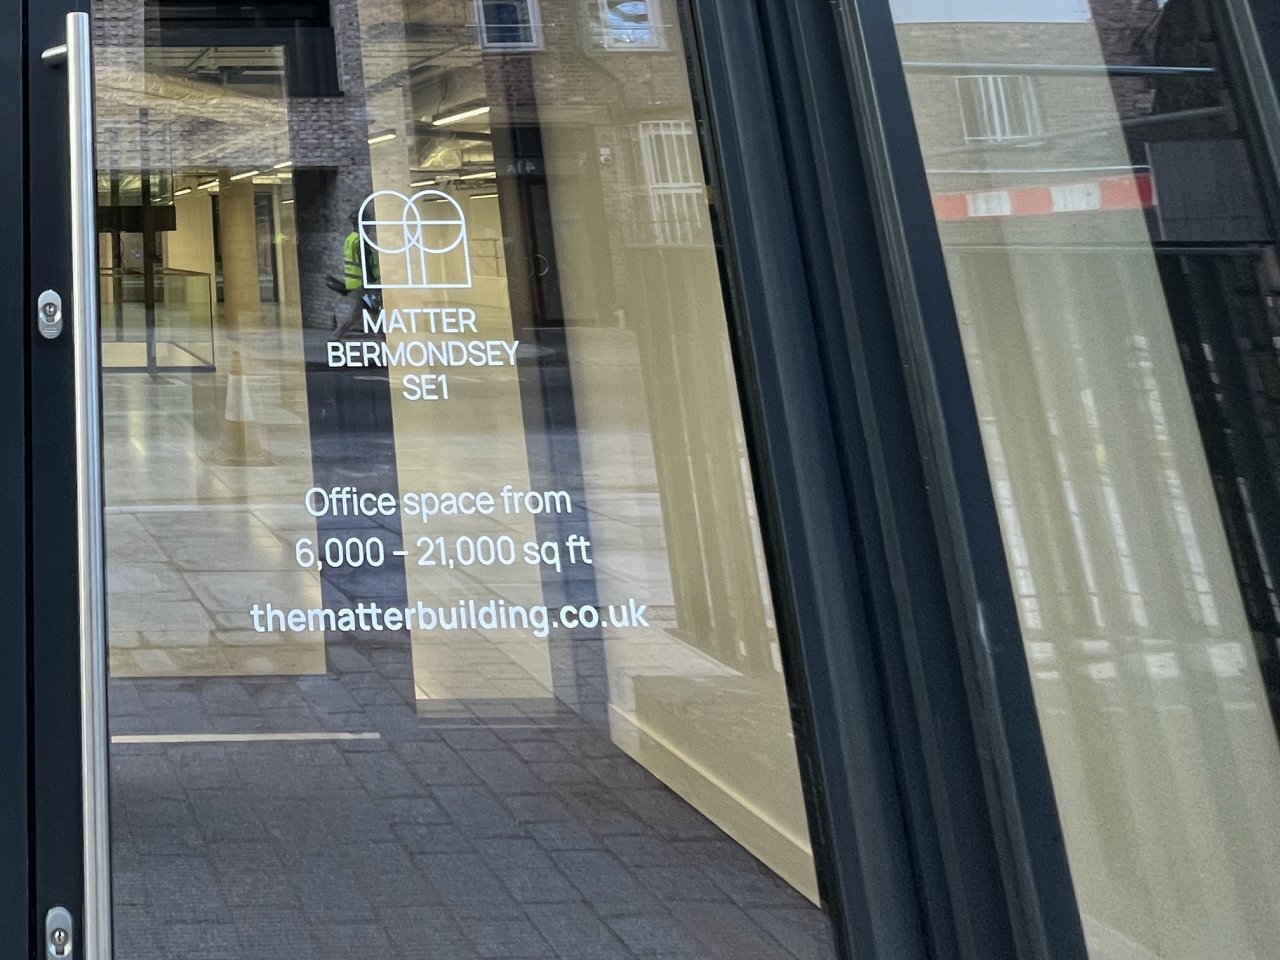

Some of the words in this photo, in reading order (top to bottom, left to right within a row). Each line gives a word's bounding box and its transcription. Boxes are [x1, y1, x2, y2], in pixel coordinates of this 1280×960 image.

[363, 308, 477, 334] MATTER
[327, 341, 520, 367] BERMONDSEY
[402, 374, 449, 400] SE1
[305, 487, 396, 517] Office
[403, 489, 495, 523] space
[500, 485, 572, 515] from
[295, 537, 384, 571] 6,000
[417, 535, 515, 568] 21,000
[523, 537, 562, 572] sq
[565, 534, 593, 565] ft
[250, 599, 649, 637] thematterbuilding.co.uk
